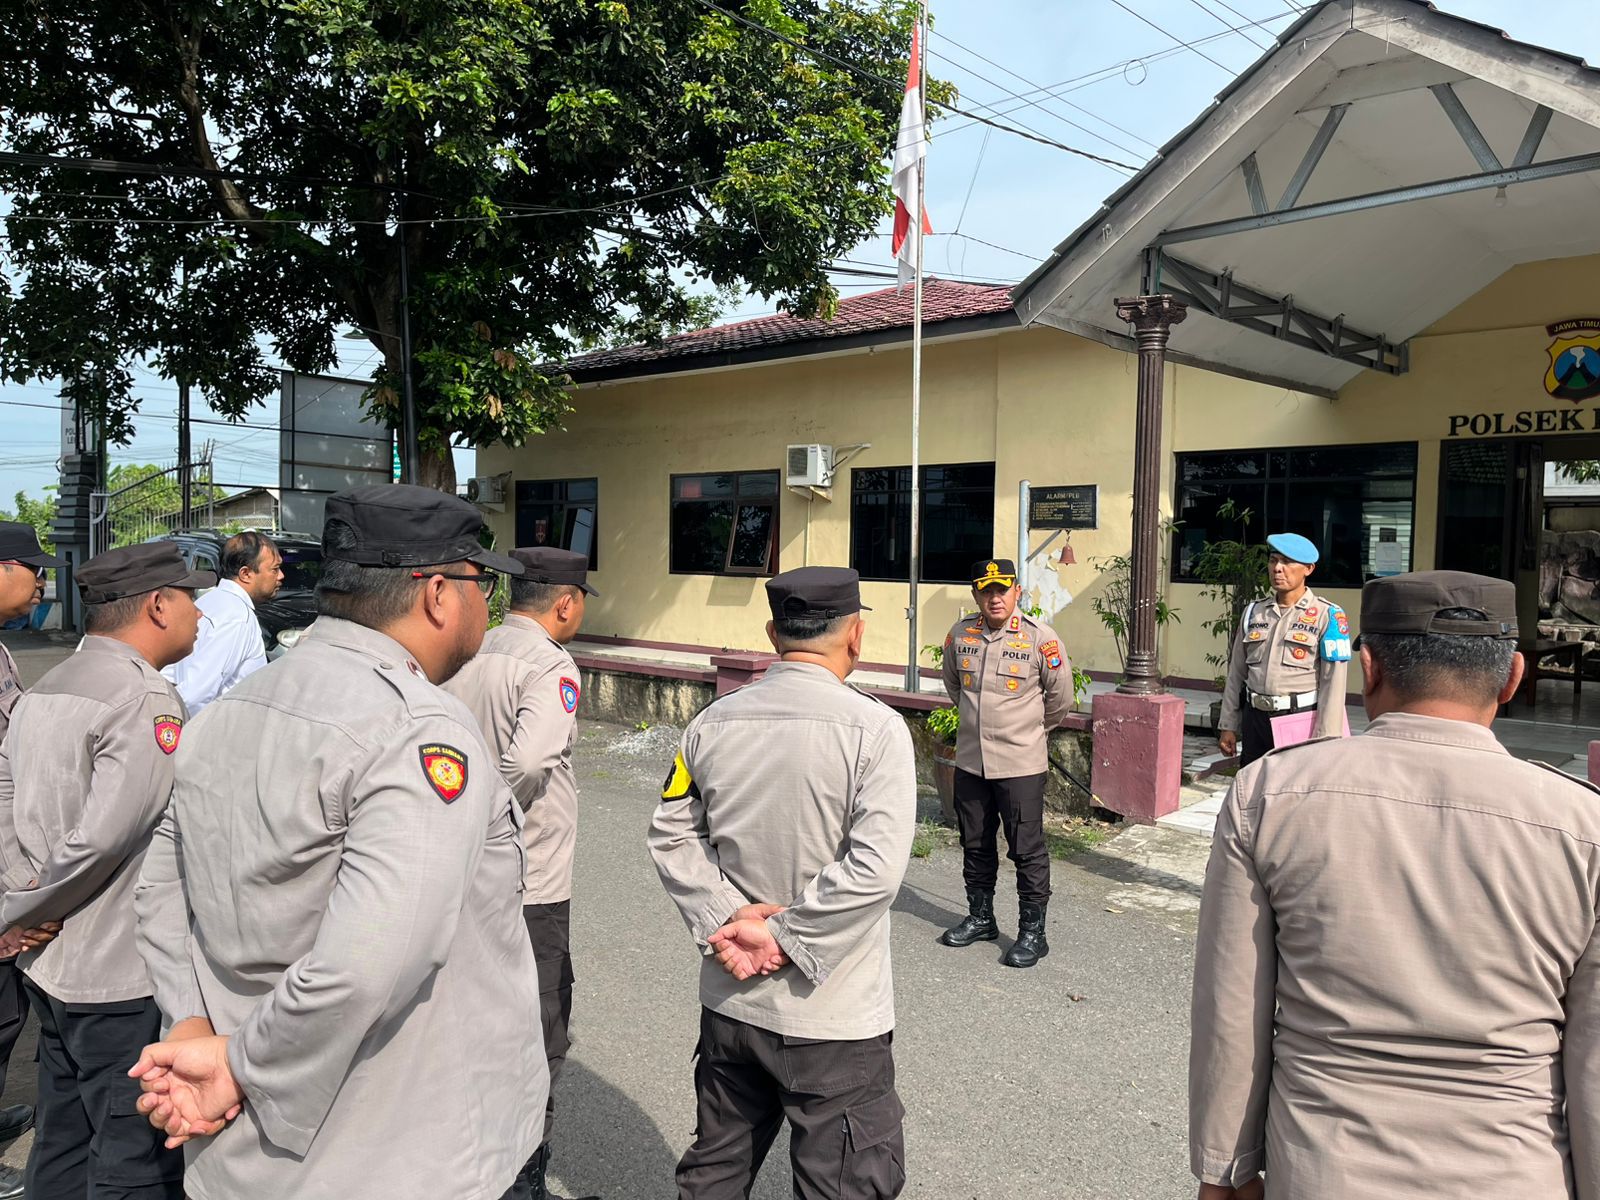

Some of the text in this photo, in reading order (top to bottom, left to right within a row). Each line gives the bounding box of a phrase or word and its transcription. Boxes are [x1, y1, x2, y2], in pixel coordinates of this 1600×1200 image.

[1553, 320, 1600, 333] JAWA TIMU
[1447, 408, 1585, 437] POLSEK
[1292, 623, 1318, 634] POLRI
[957, 645, 979, 656] LATIF
[1002, 650, 1030, 661] POLRI
